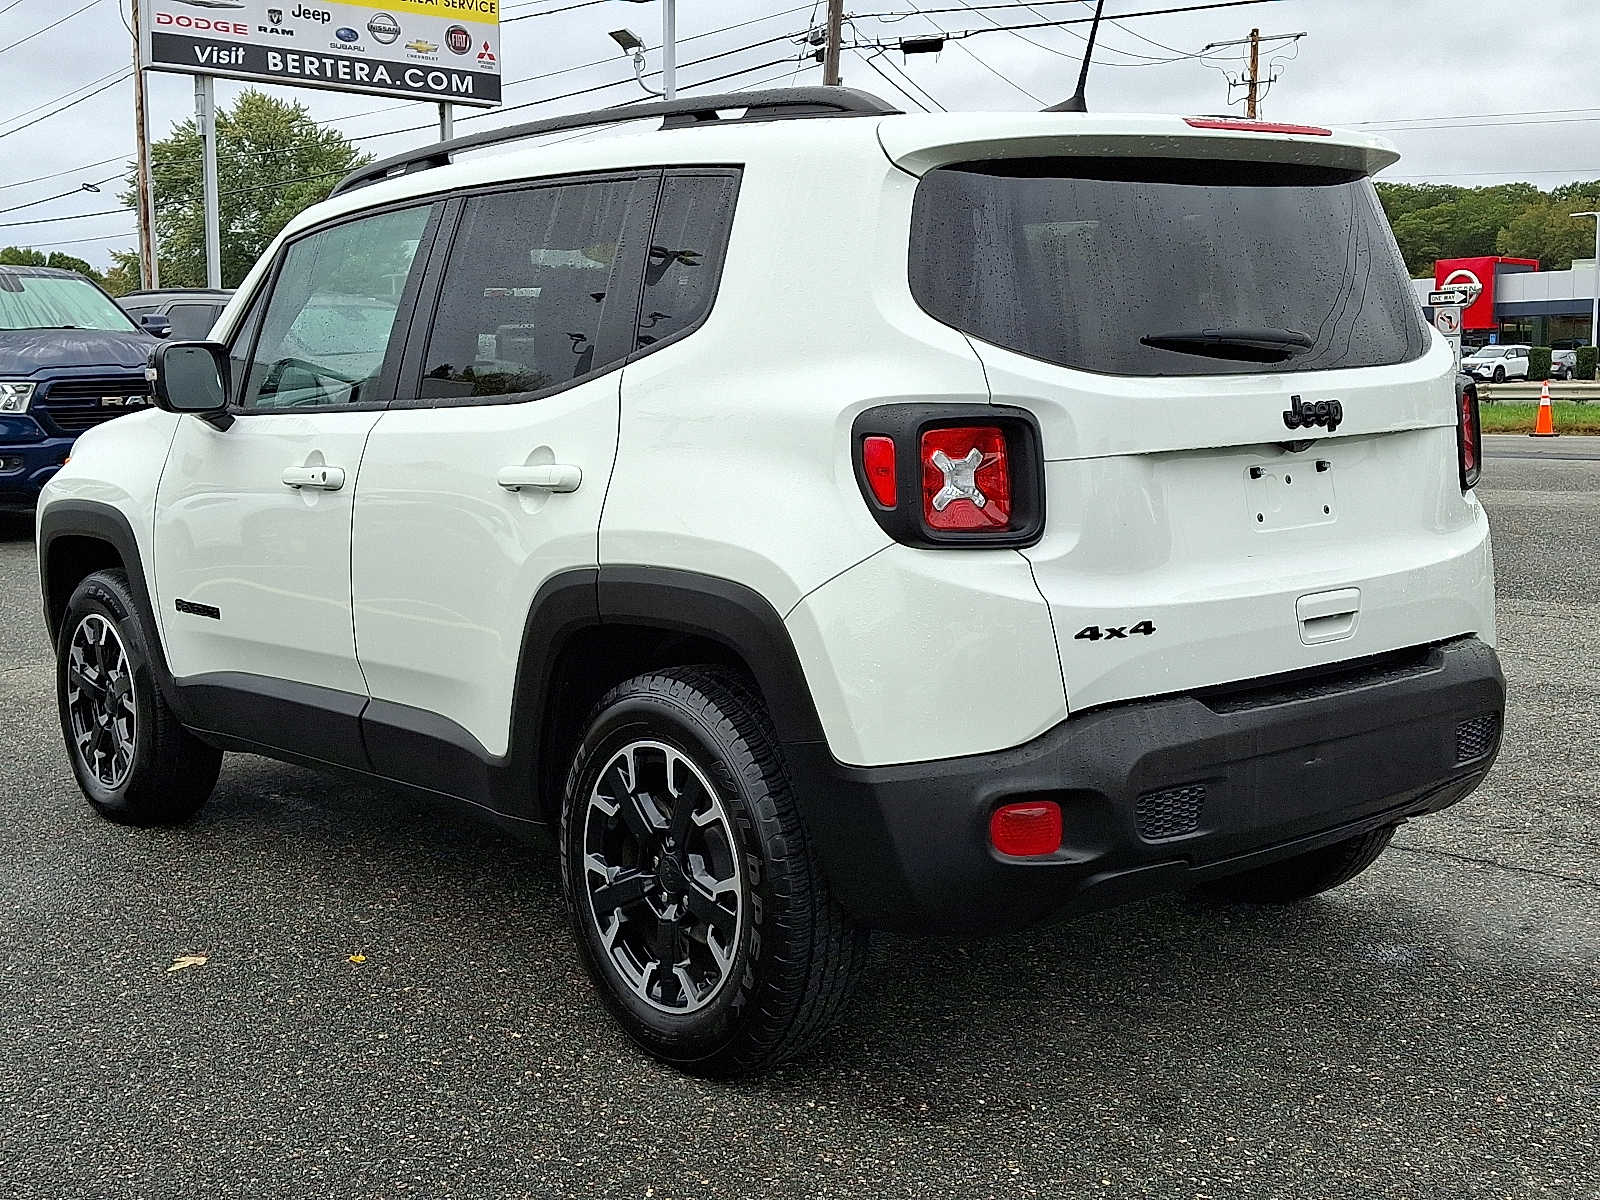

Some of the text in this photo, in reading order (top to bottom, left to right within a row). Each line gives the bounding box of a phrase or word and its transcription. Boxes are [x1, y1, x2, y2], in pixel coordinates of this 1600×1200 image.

[291, 4, 331, 24] Jeep
[443, 0, 496, 13] SERVICE
[156, 13, 249, 35] DODGE
[258, 26, 294, 36] RAM
[370, 24, 399, 34] NISSAN
[329, 42, 365, 52] SUBARU
[452, 33, 467, 48] FIAT
[193, 45, 474, 94] Visit BERTERA.COM
[101, 396, 154, 405] RA
[1283, 395, 1343, 432] Jeep
[1074, 620, 1156, 642] 4x4
